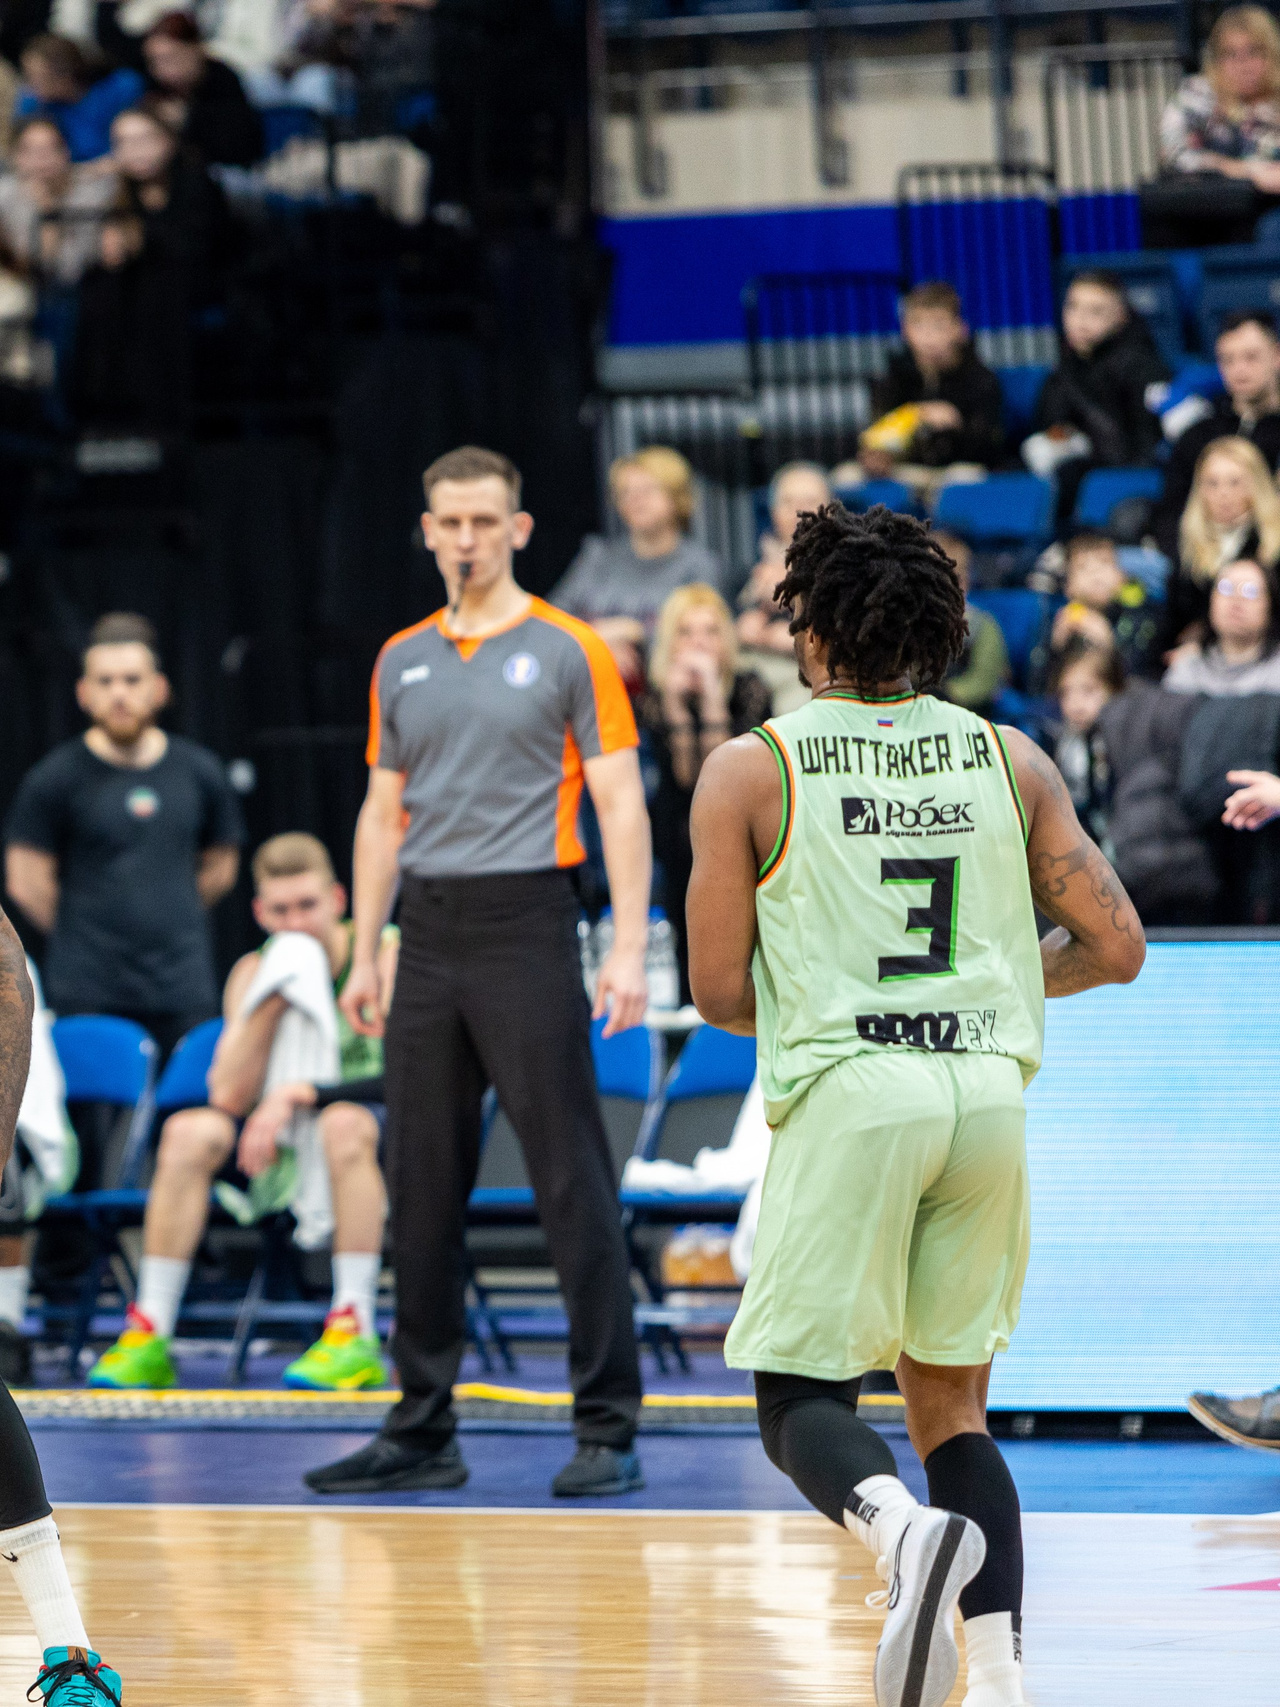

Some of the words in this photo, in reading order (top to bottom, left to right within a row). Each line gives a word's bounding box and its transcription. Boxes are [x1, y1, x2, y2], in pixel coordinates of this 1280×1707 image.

[797, 732, 954, 779] WHITTAKER
[962, 732, 993, 772] JR
[882, 794, 974, 828] Робек
[878, 856, 960, 983] 3
